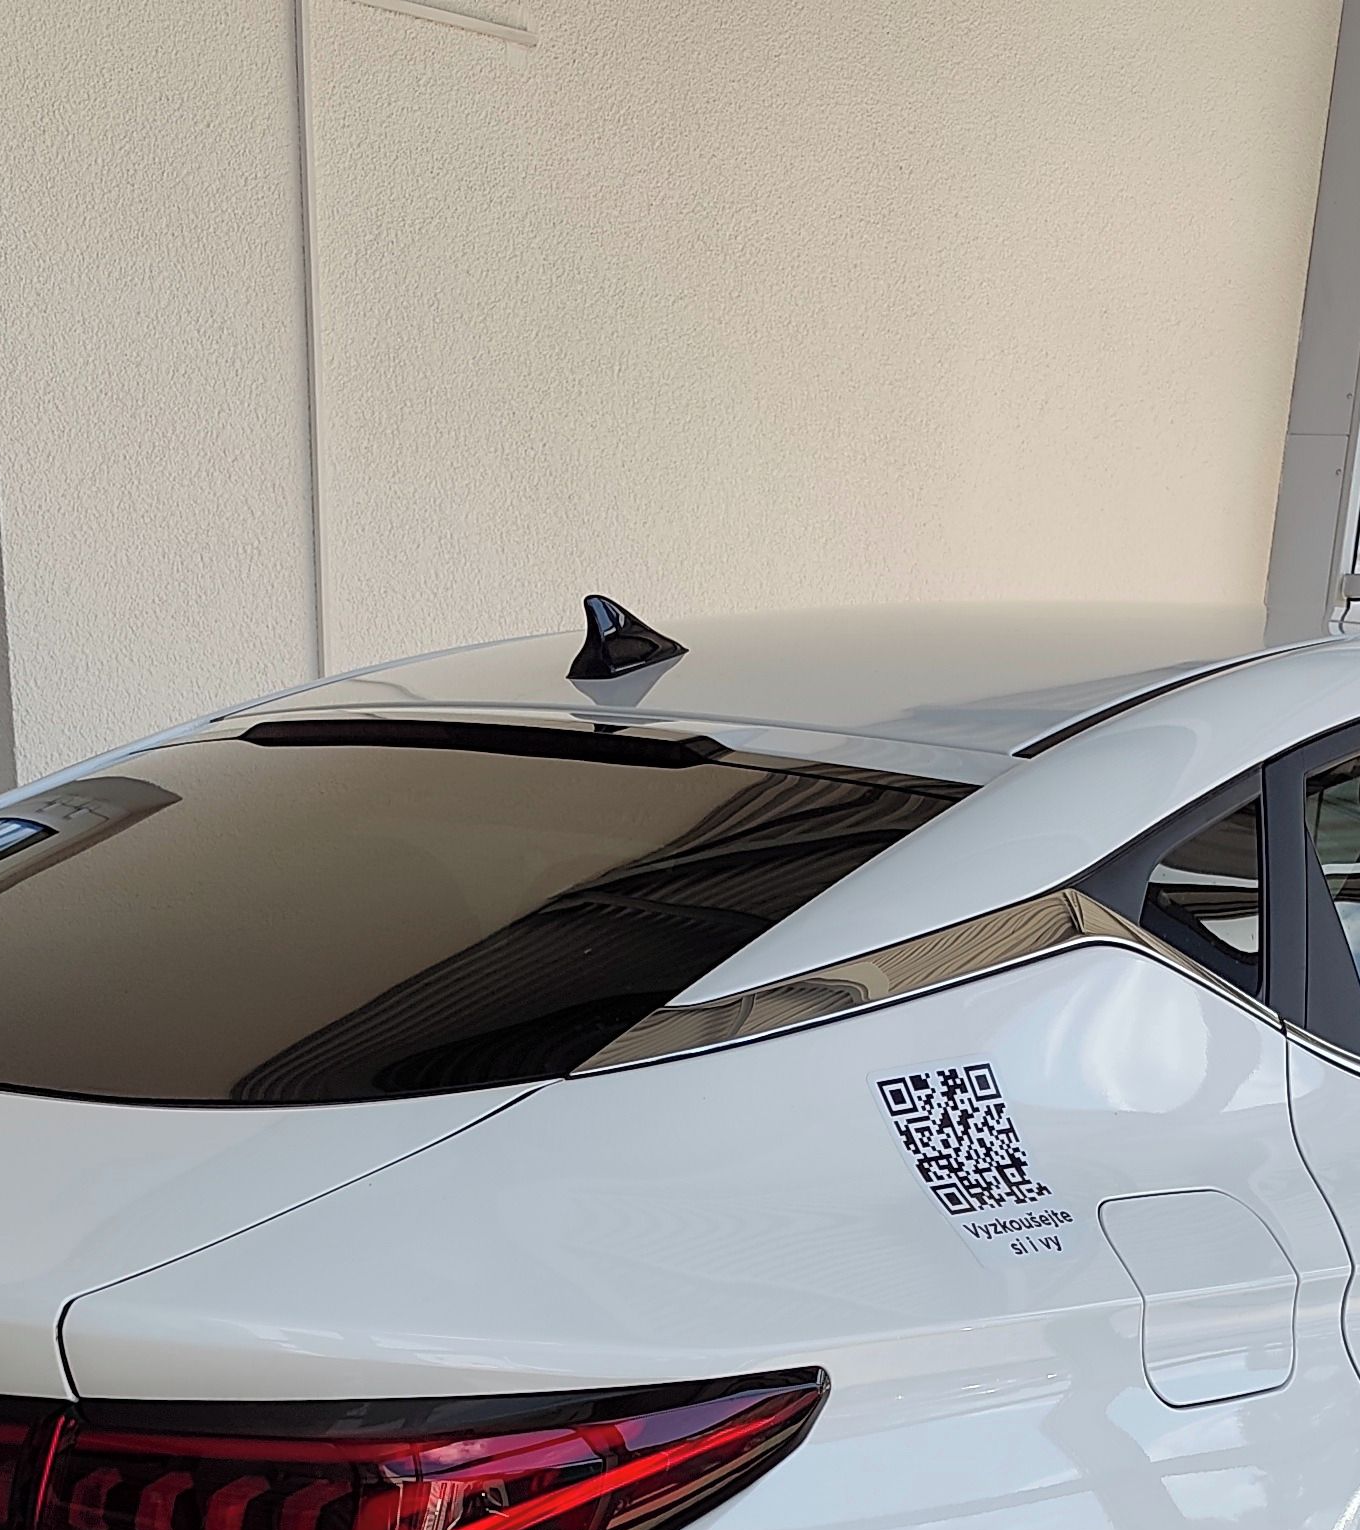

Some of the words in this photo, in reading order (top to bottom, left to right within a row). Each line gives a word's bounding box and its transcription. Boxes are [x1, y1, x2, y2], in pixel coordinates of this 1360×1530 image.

[962, 1209, 1074, 1240] Vyzkoušejte
[1010, 1237, 1029, 1255] si
[1025, 1236, 1039, 1252] i
[1038, 1235, 1063, 1252] vy
